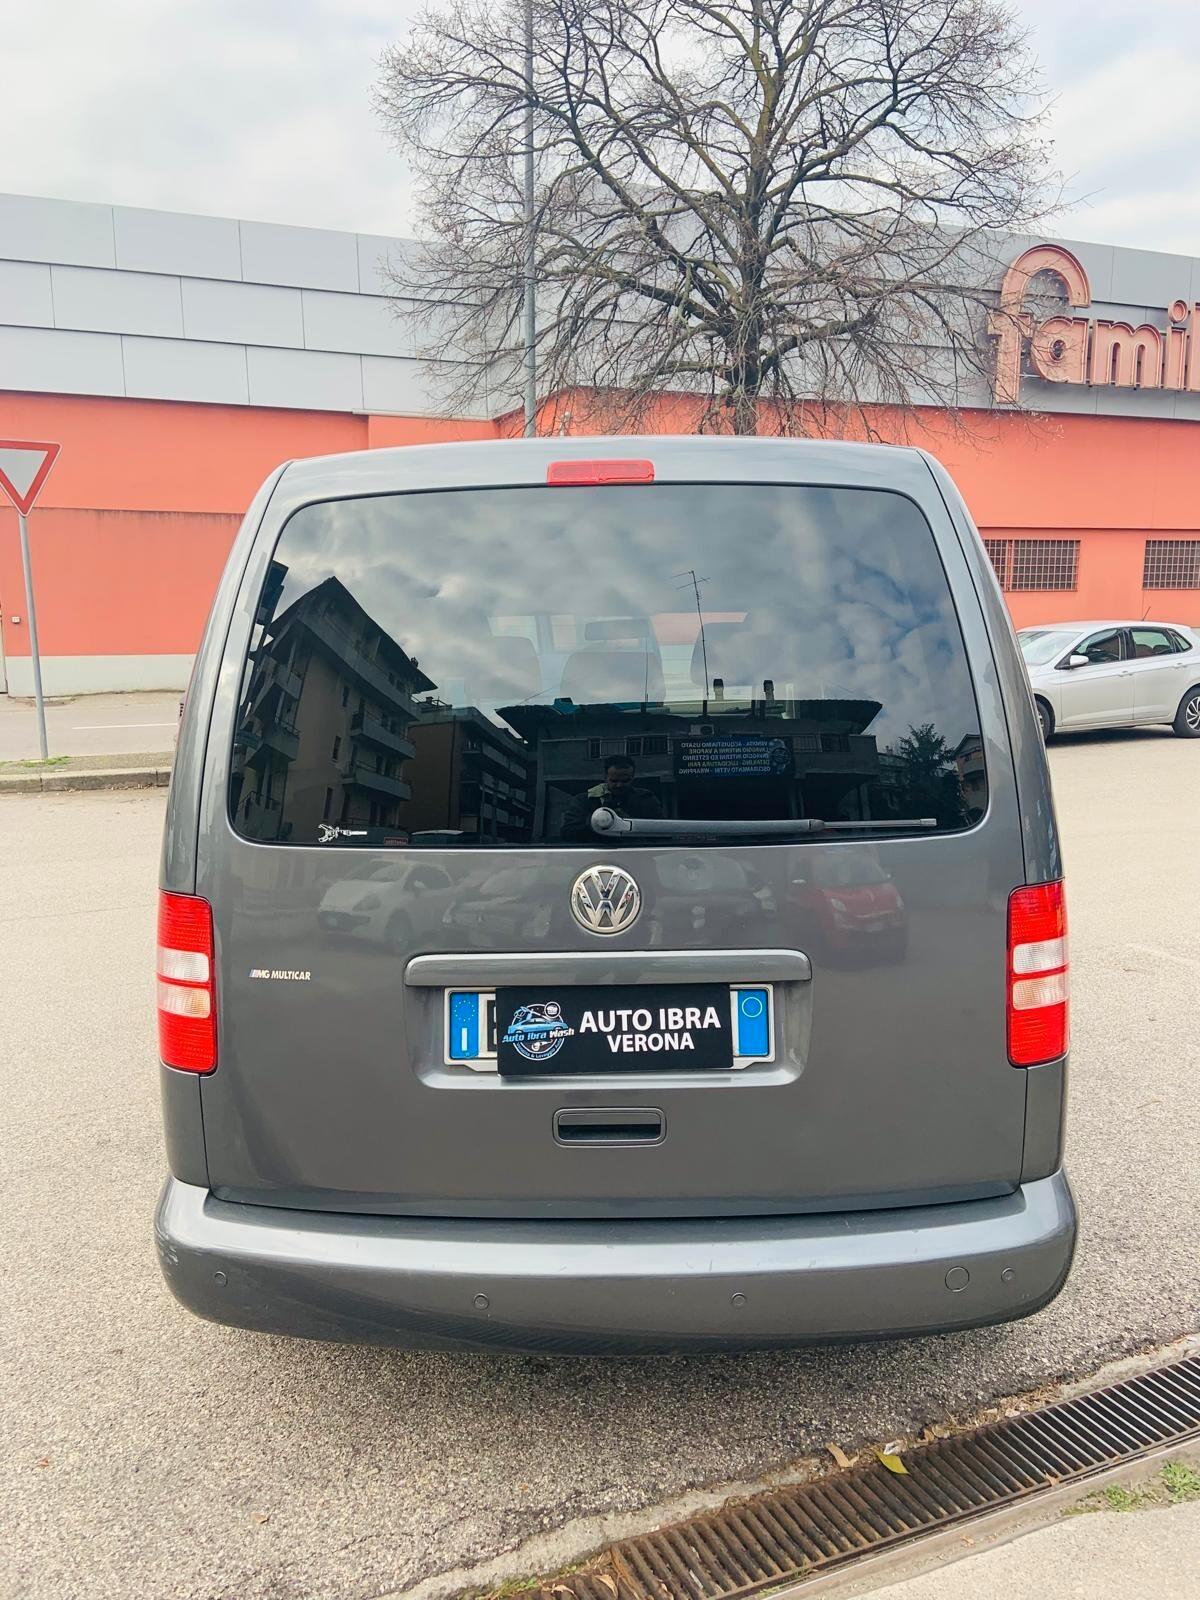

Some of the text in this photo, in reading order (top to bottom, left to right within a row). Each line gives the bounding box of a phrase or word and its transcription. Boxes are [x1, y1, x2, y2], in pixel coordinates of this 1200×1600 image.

[271, 970, 311, 981] MULTICAR
[579, 1006, 721, 1034] AUTO IBRA
[502, 1027, 575, 1043] Auto Ibra Wash
[607, 1032, 695, 1053] VERONA
